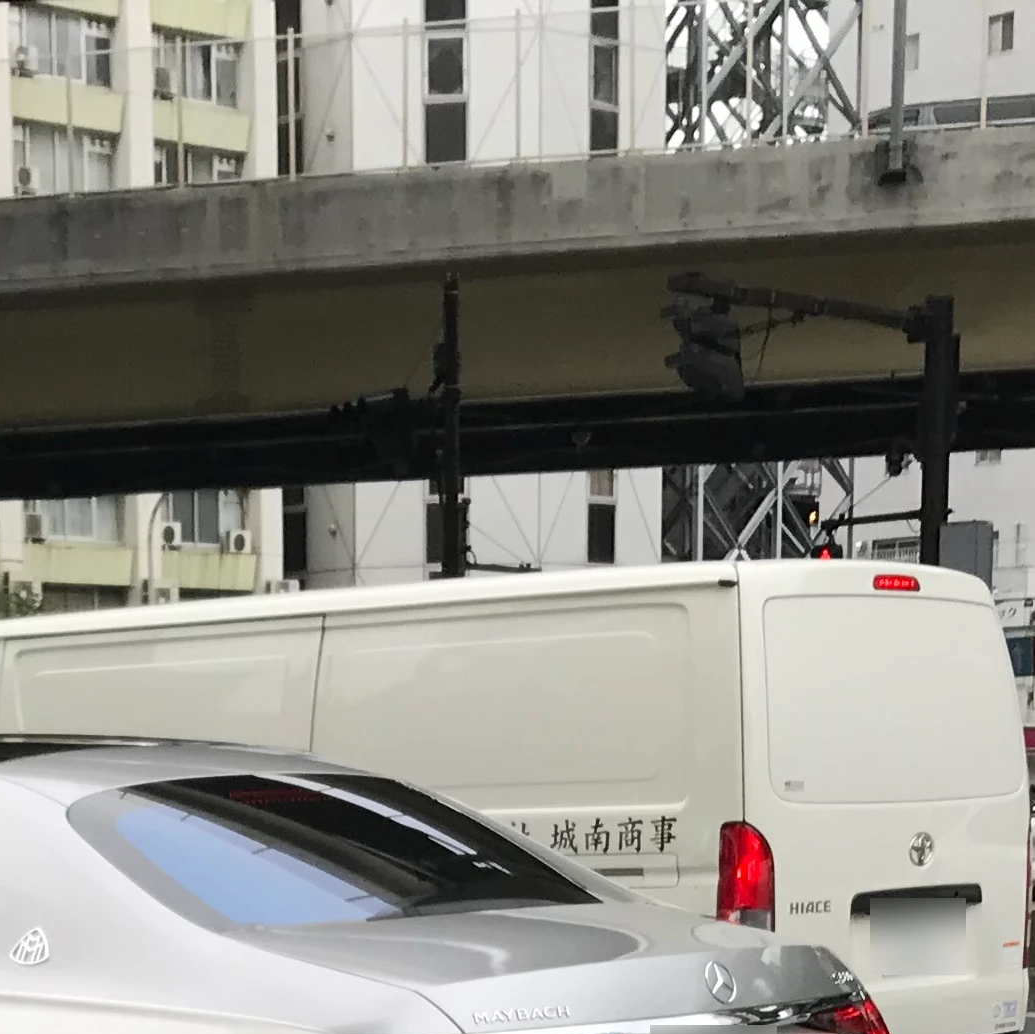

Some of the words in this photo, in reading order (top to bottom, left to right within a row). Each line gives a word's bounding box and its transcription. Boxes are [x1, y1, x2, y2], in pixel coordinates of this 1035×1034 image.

[550, 815, 677, 854] 城南商事
[789, 900, 832, 915] HIACE
[473, 1005, 571, 1025] MAYBACH
